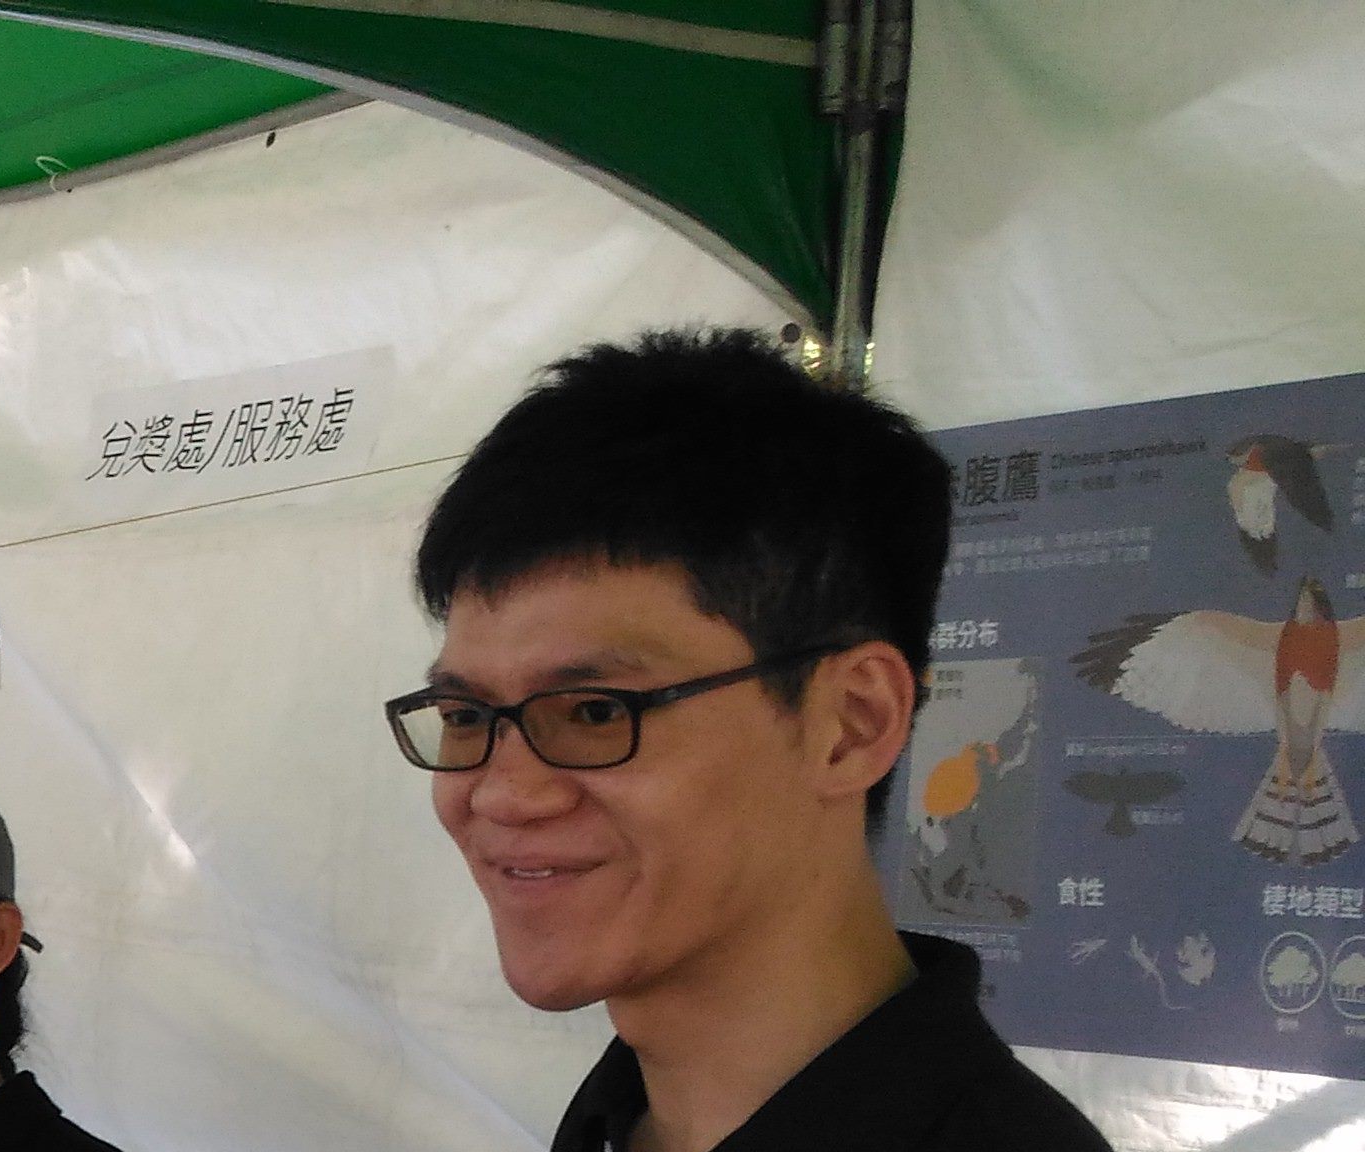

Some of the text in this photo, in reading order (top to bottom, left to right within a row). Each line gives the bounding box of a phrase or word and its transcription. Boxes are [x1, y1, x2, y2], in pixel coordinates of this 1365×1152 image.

[85, 386, 355, 481] 兌獎處/服務處
